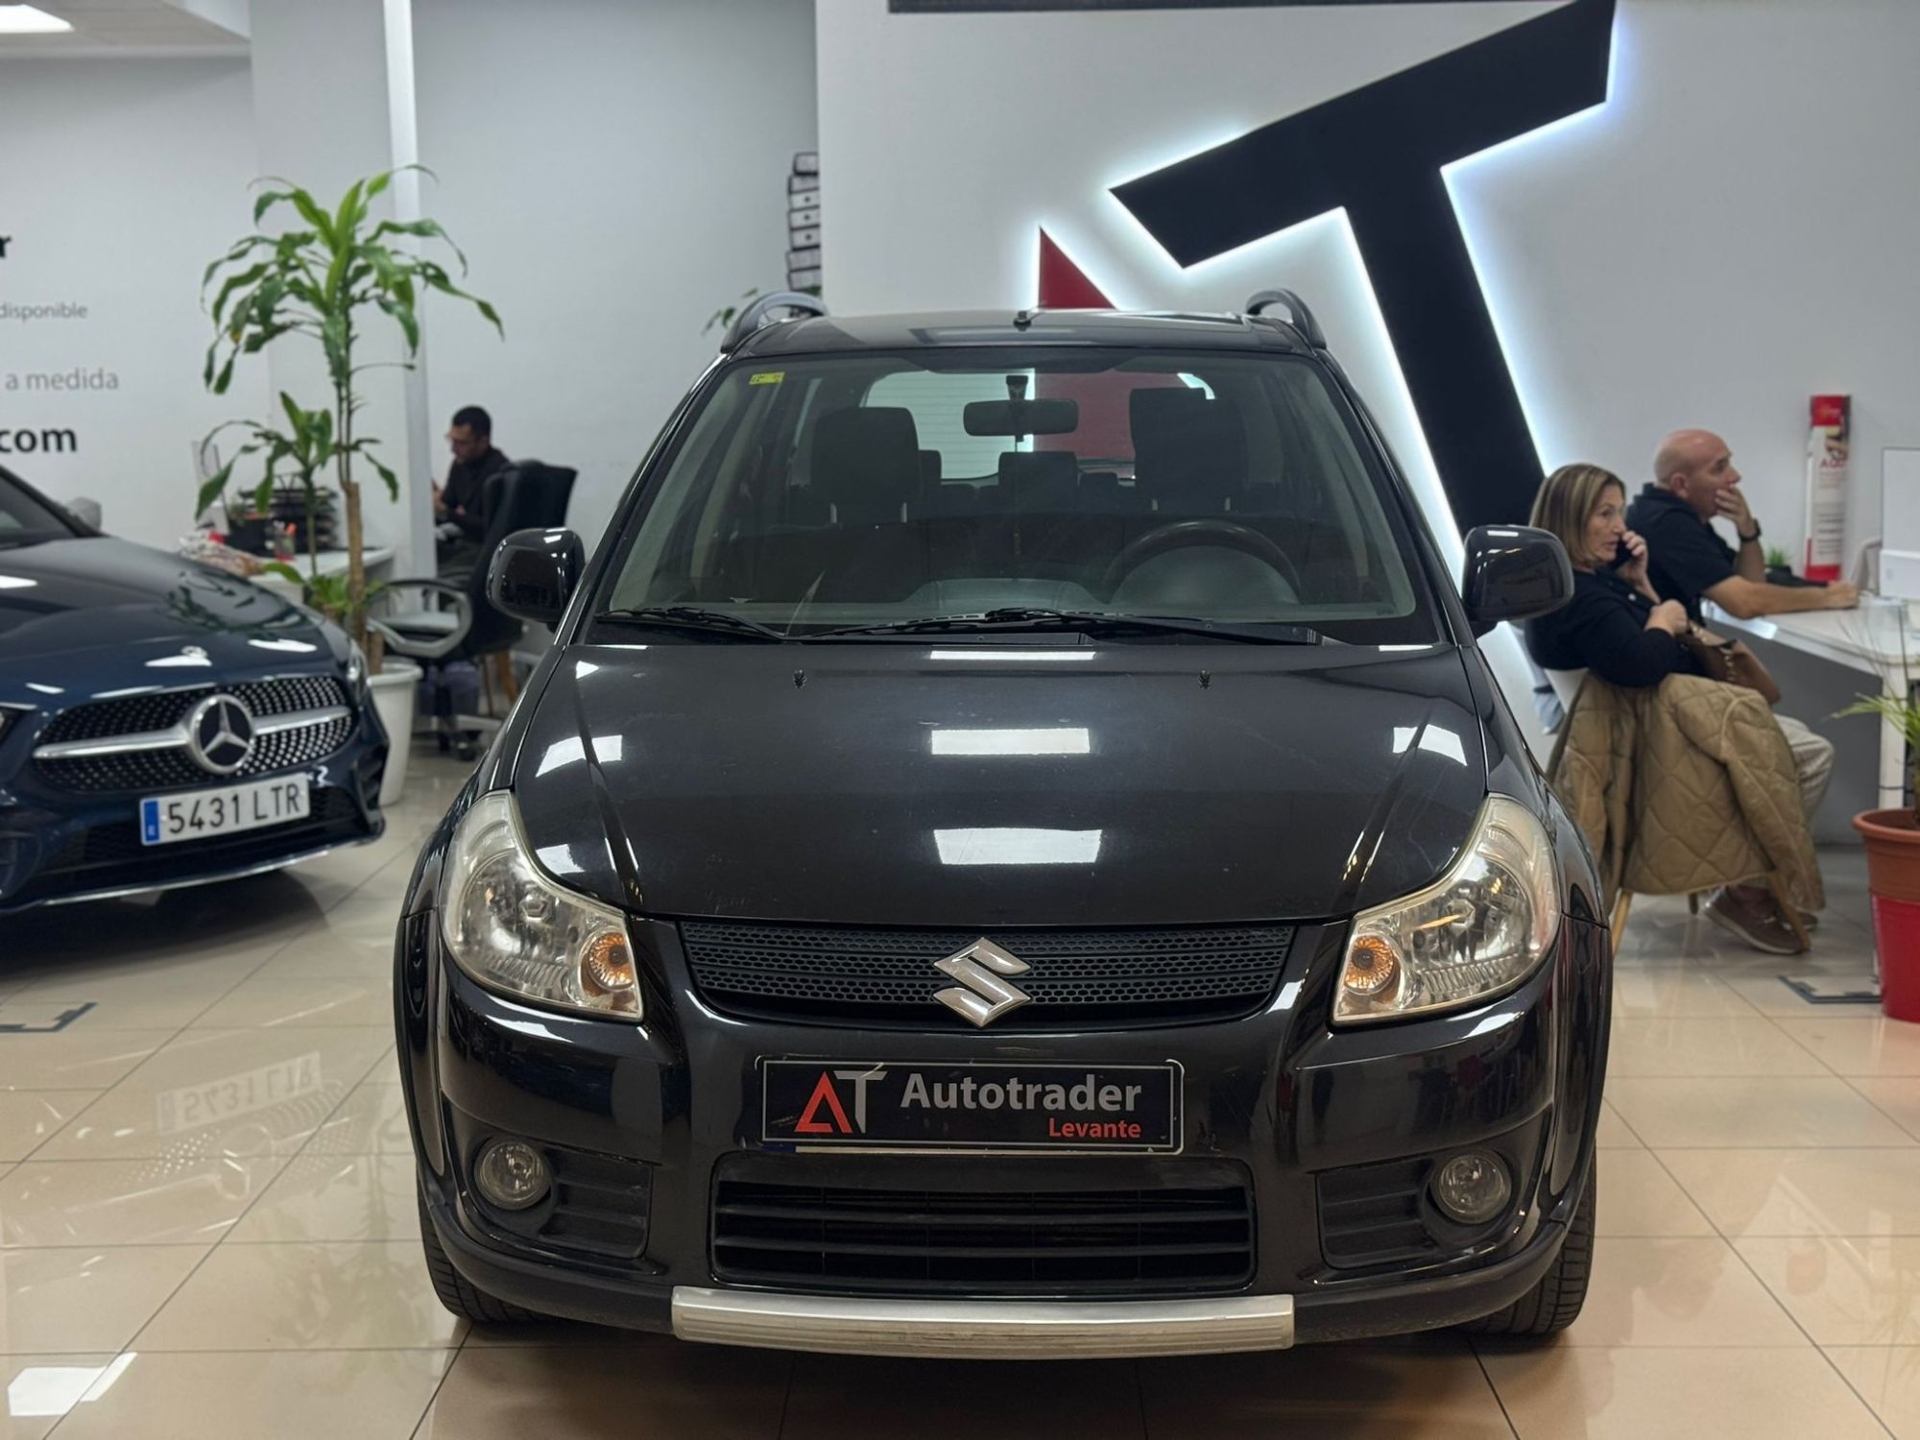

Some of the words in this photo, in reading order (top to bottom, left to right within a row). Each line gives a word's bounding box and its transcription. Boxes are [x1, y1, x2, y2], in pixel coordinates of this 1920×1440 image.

[5, 373, 18, 390] a
[26, 369, 119, 390] medida
[168, 794, 239, 834] 5431
[254, 784, 300, 820] LTR
[900, 1072, 1142, 1112] Autotrader
[1049, 1117, 1141, 1139] Levante
